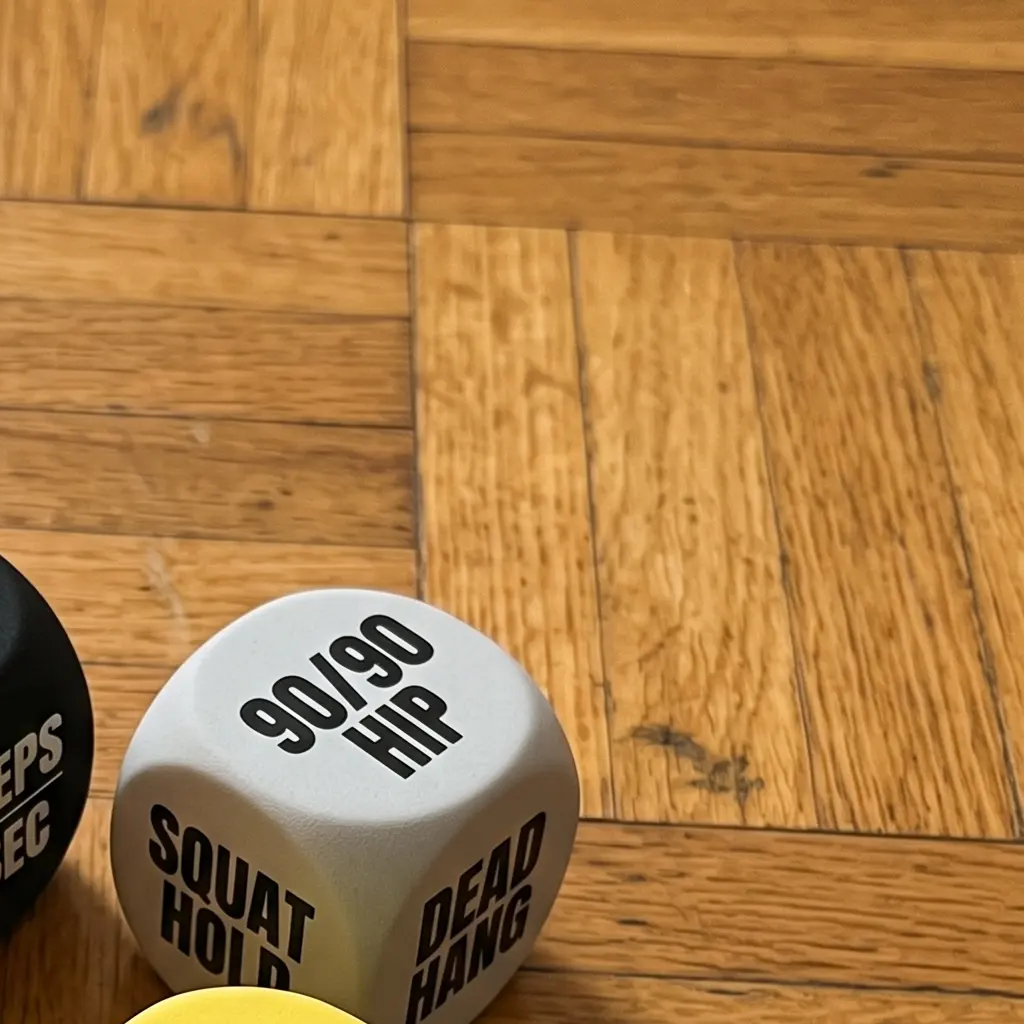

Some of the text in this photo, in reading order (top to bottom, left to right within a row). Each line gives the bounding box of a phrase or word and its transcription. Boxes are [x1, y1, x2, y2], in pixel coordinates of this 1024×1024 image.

[239, 614, 434, 754] 90/90
[341, 685, 463, 780] HIP
[149, 803, 316, 964] SQUAT
[416, 811, 546, 968] DEAD
